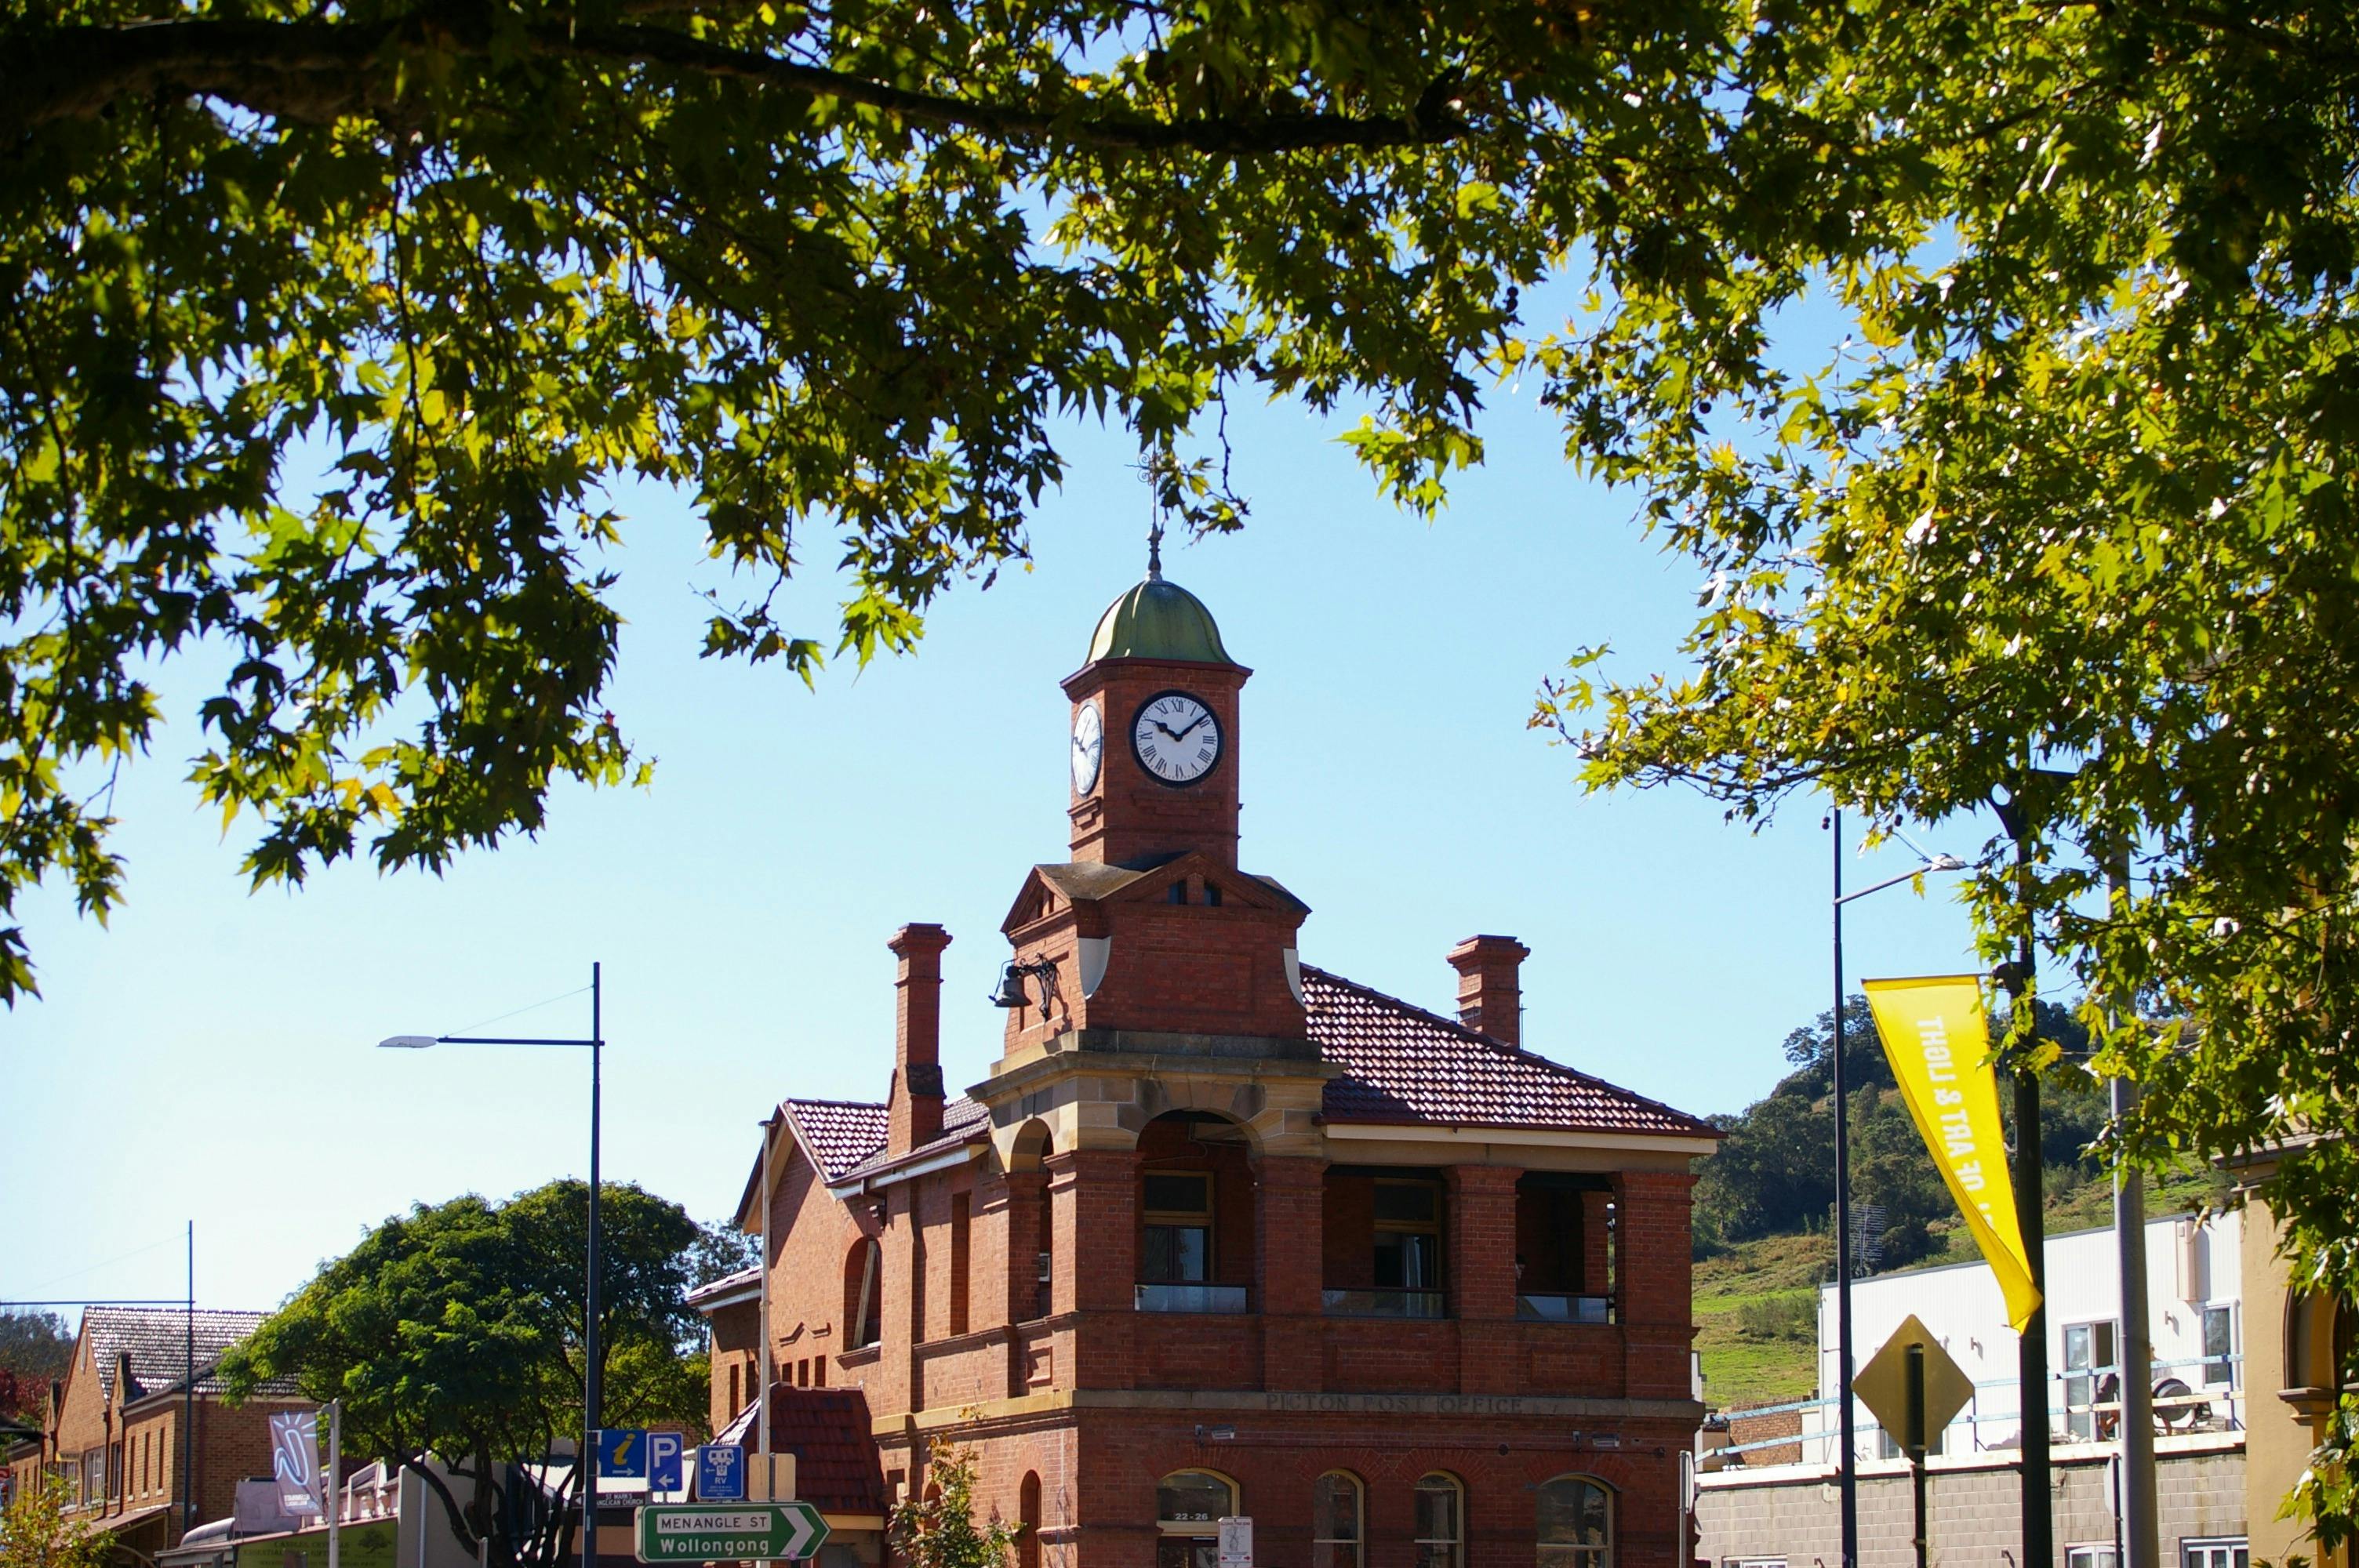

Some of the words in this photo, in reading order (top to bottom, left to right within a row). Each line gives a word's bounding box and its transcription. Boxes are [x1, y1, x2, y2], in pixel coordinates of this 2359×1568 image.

[1266, 1394, 1350, 1410] PICTON
[1363, 1395, 1427, 1412] POST
[1440, 1396, 1521, 1414] OFFICE
[653, 1438, 677, 1468] P
[661, 1517, 740, 1529] MENANGLE
[750, 1516, 767, 1528] ST
[660, 1537, 769, 1555] Wollongong
